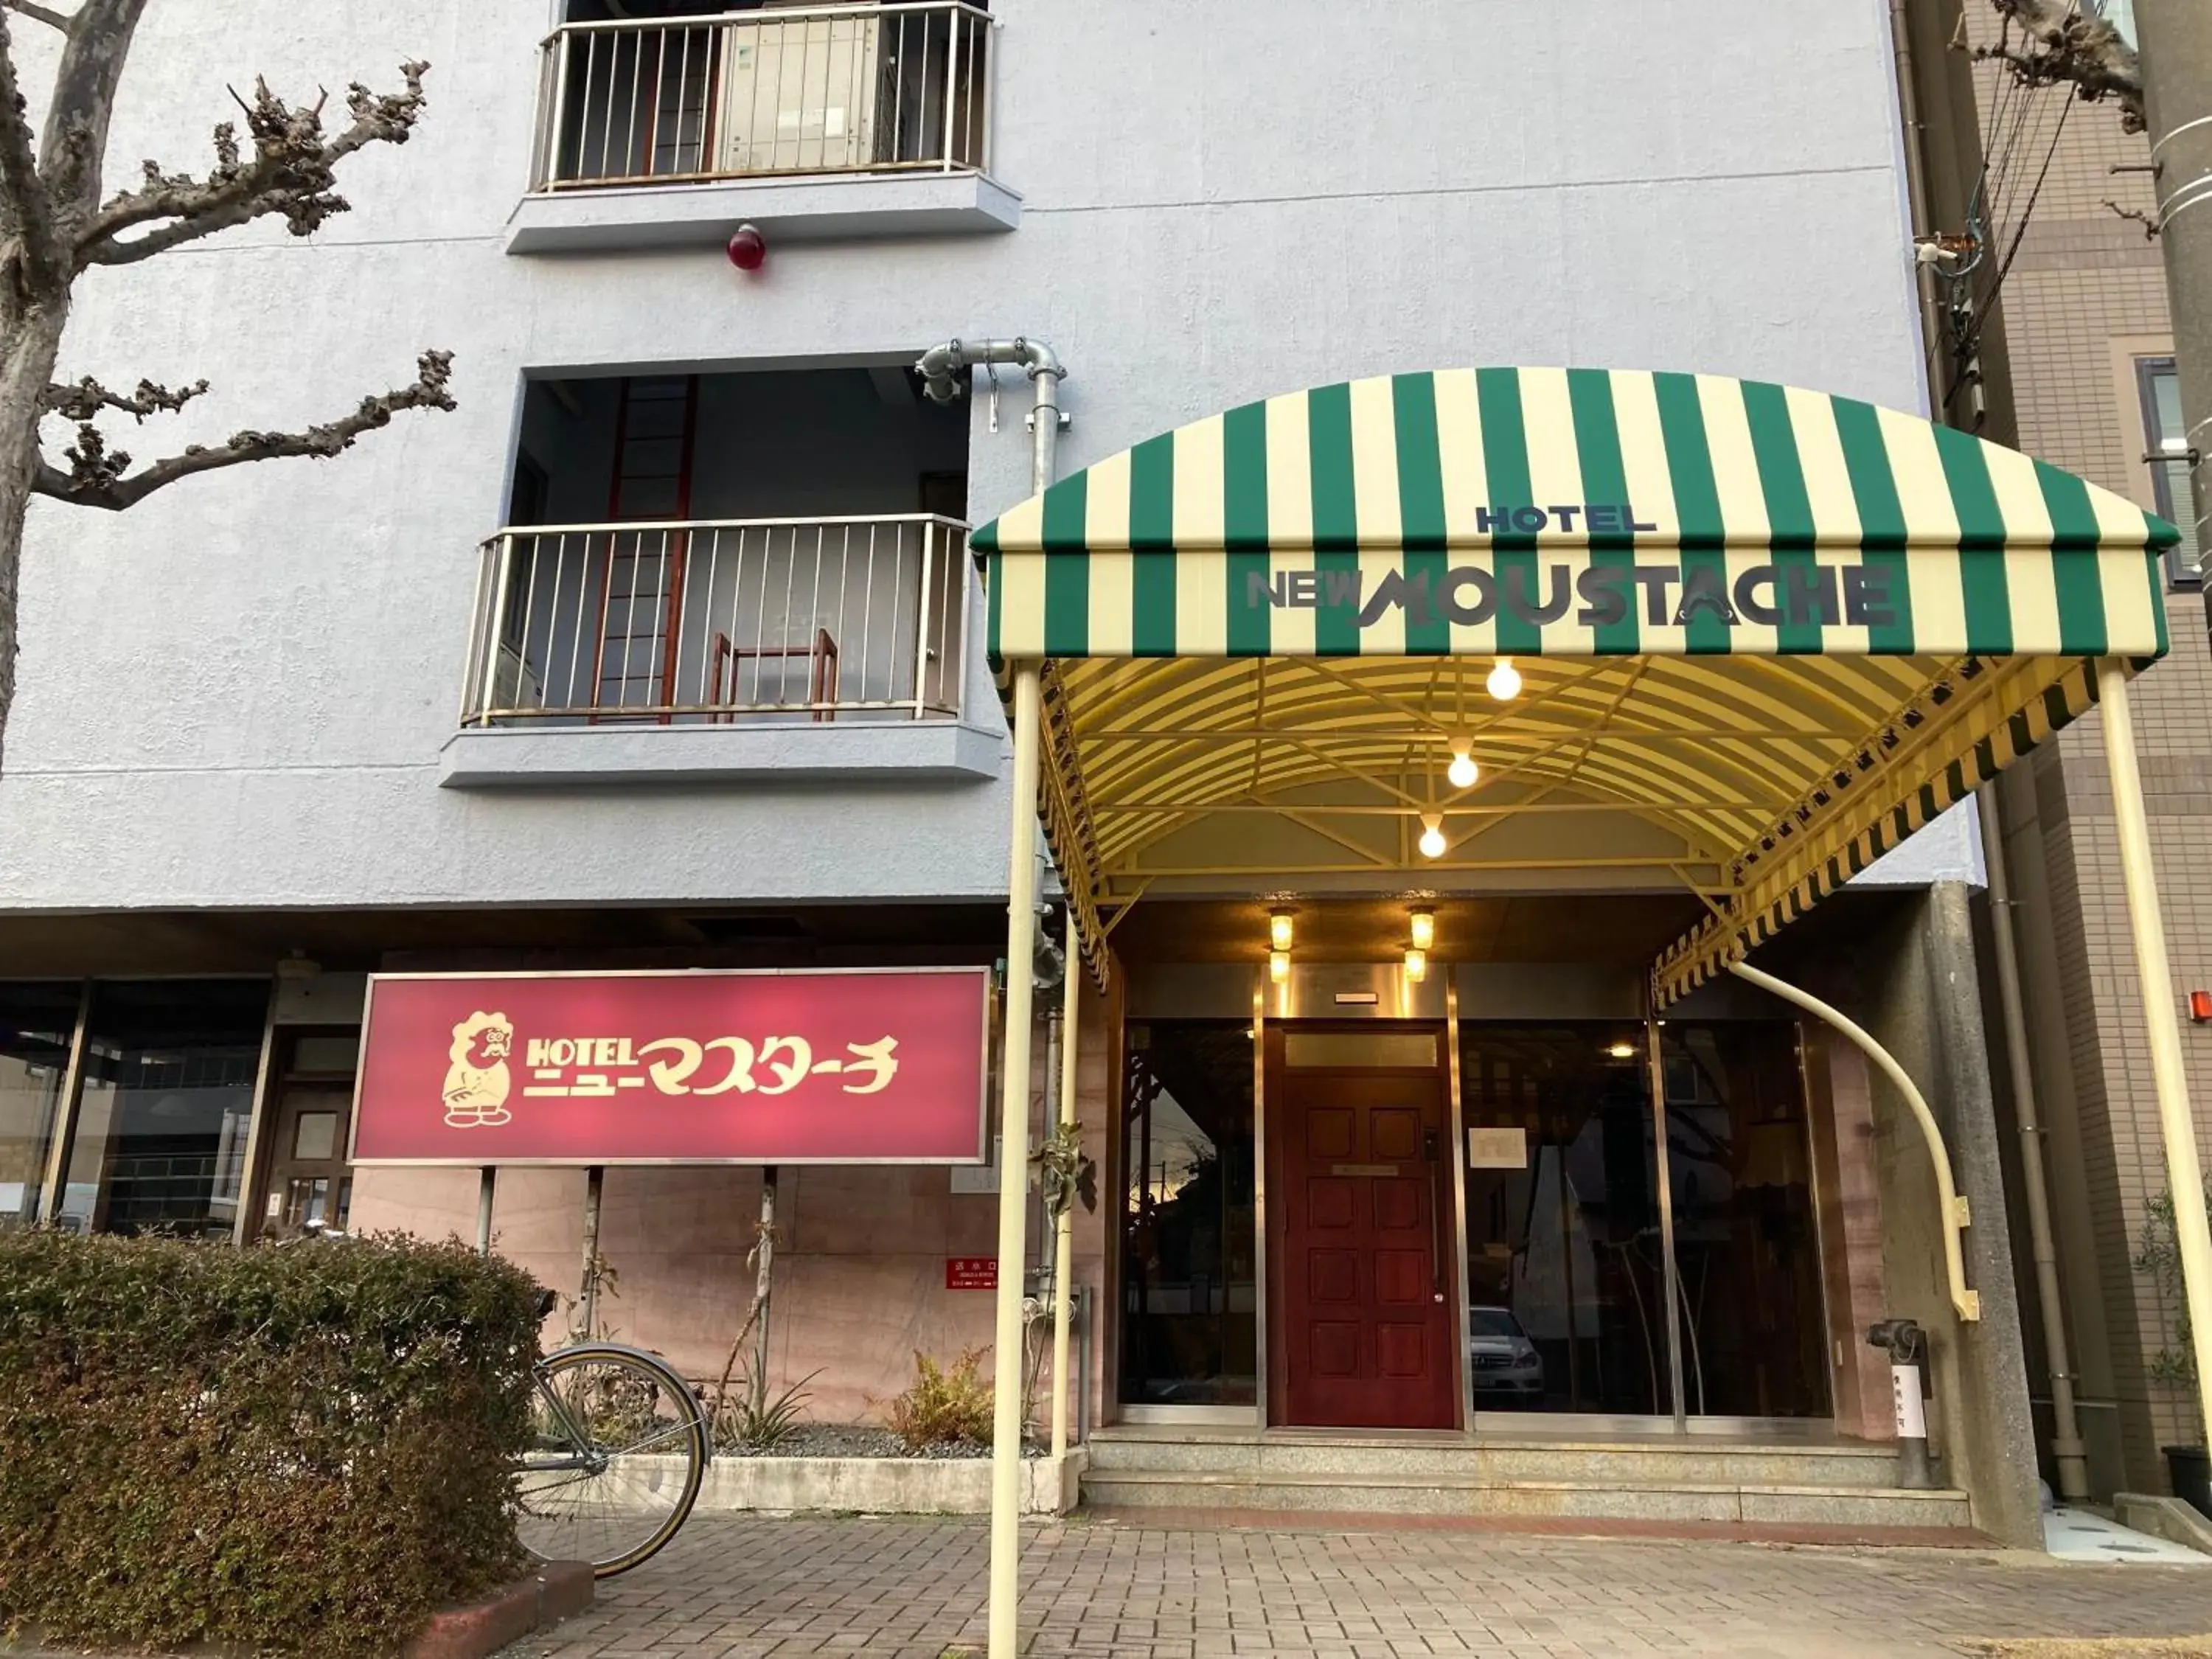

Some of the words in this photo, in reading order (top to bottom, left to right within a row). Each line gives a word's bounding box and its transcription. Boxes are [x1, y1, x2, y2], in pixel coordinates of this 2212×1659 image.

[1476, 505, 1658, 533] HOTEL
[1247, 570, 1363, 609] NEW
[1349, 565, 1895, 627] MOUSTACHE
[526, 1037, 639, 1067] HOTEL
